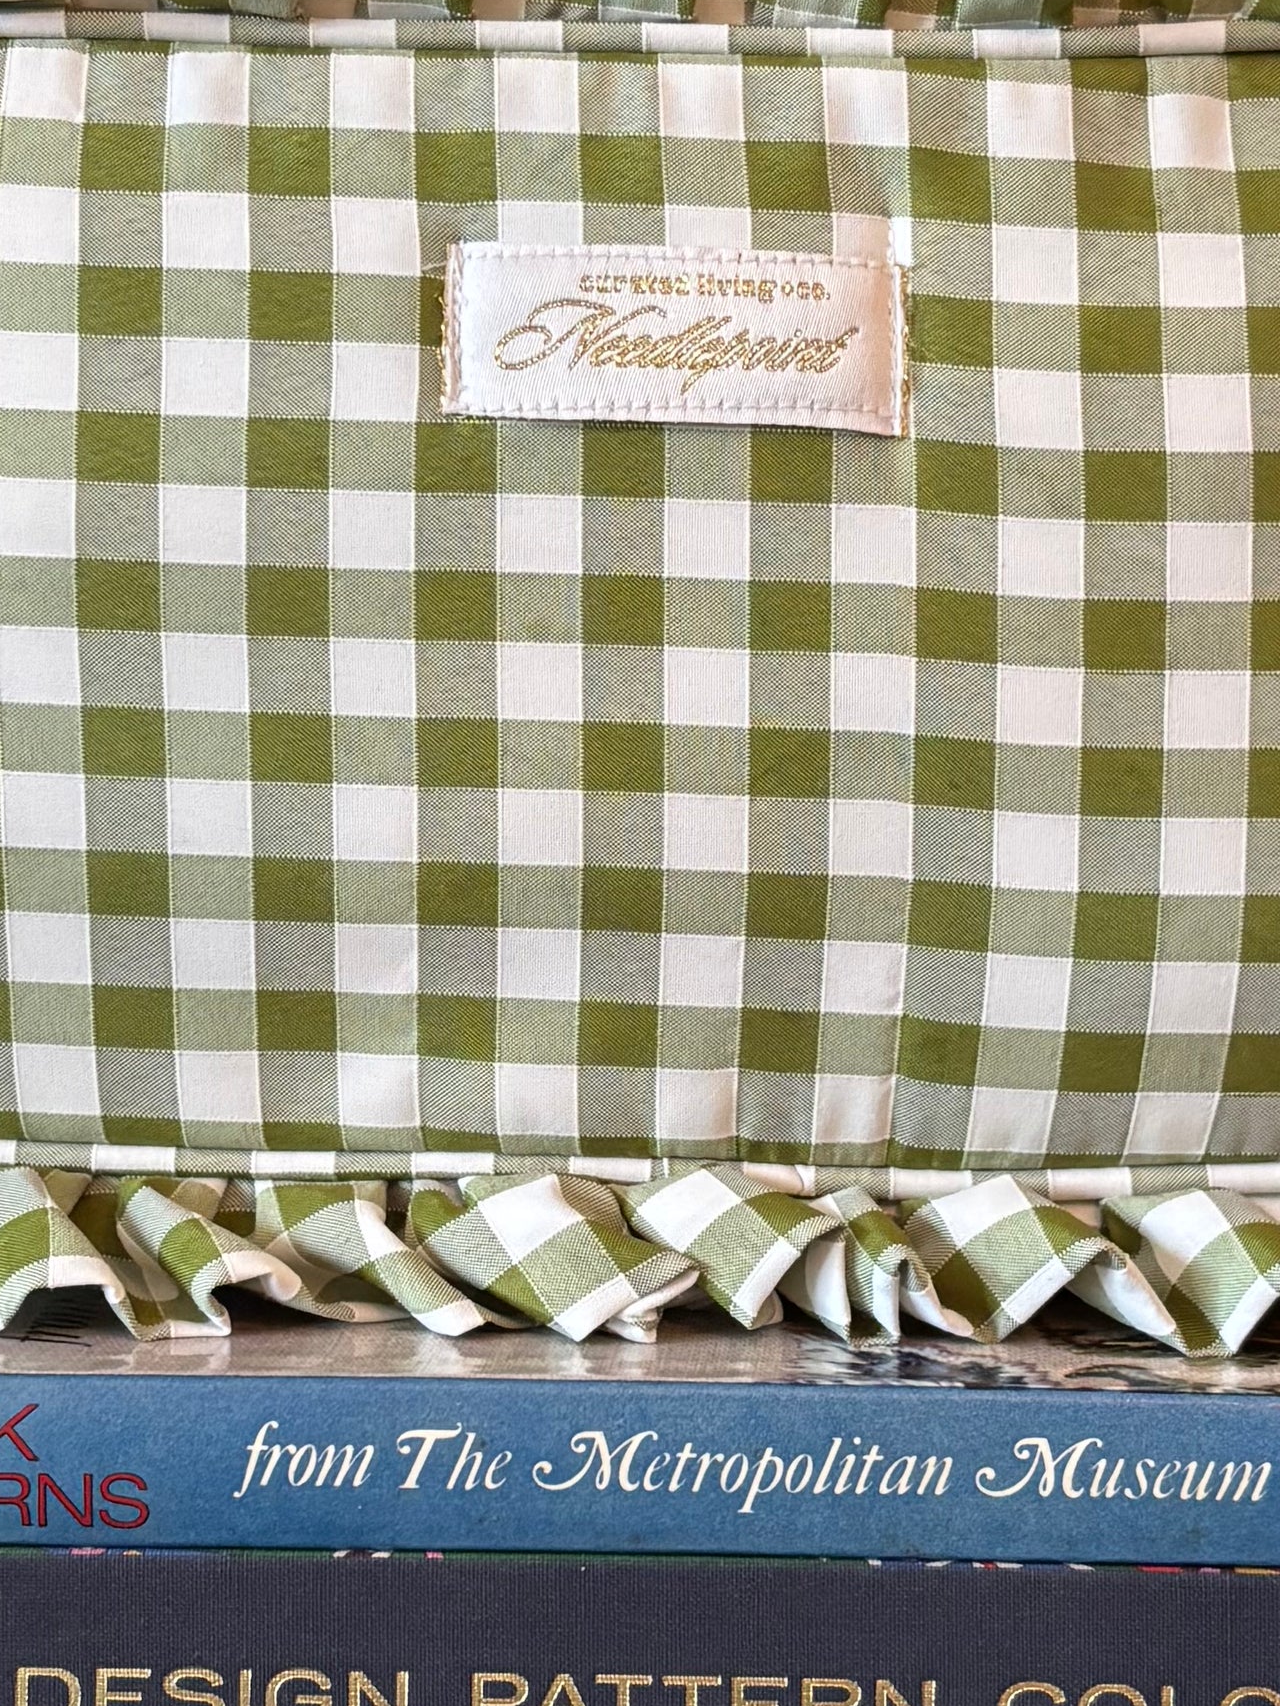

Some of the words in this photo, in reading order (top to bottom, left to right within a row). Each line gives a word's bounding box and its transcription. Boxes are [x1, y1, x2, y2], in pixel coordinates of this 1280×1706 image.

[580, 273, 690, 294] curated
[697, 273, 777, 304] living
[495, 297, 860, 396] Needlepoint
[233, 1420, 375, 1497] from
[397, 1423, 512, 1492] The
[532, 1431, 953, 1513] Metropolitan
[975, 1438, 1272, 1503] Museum
